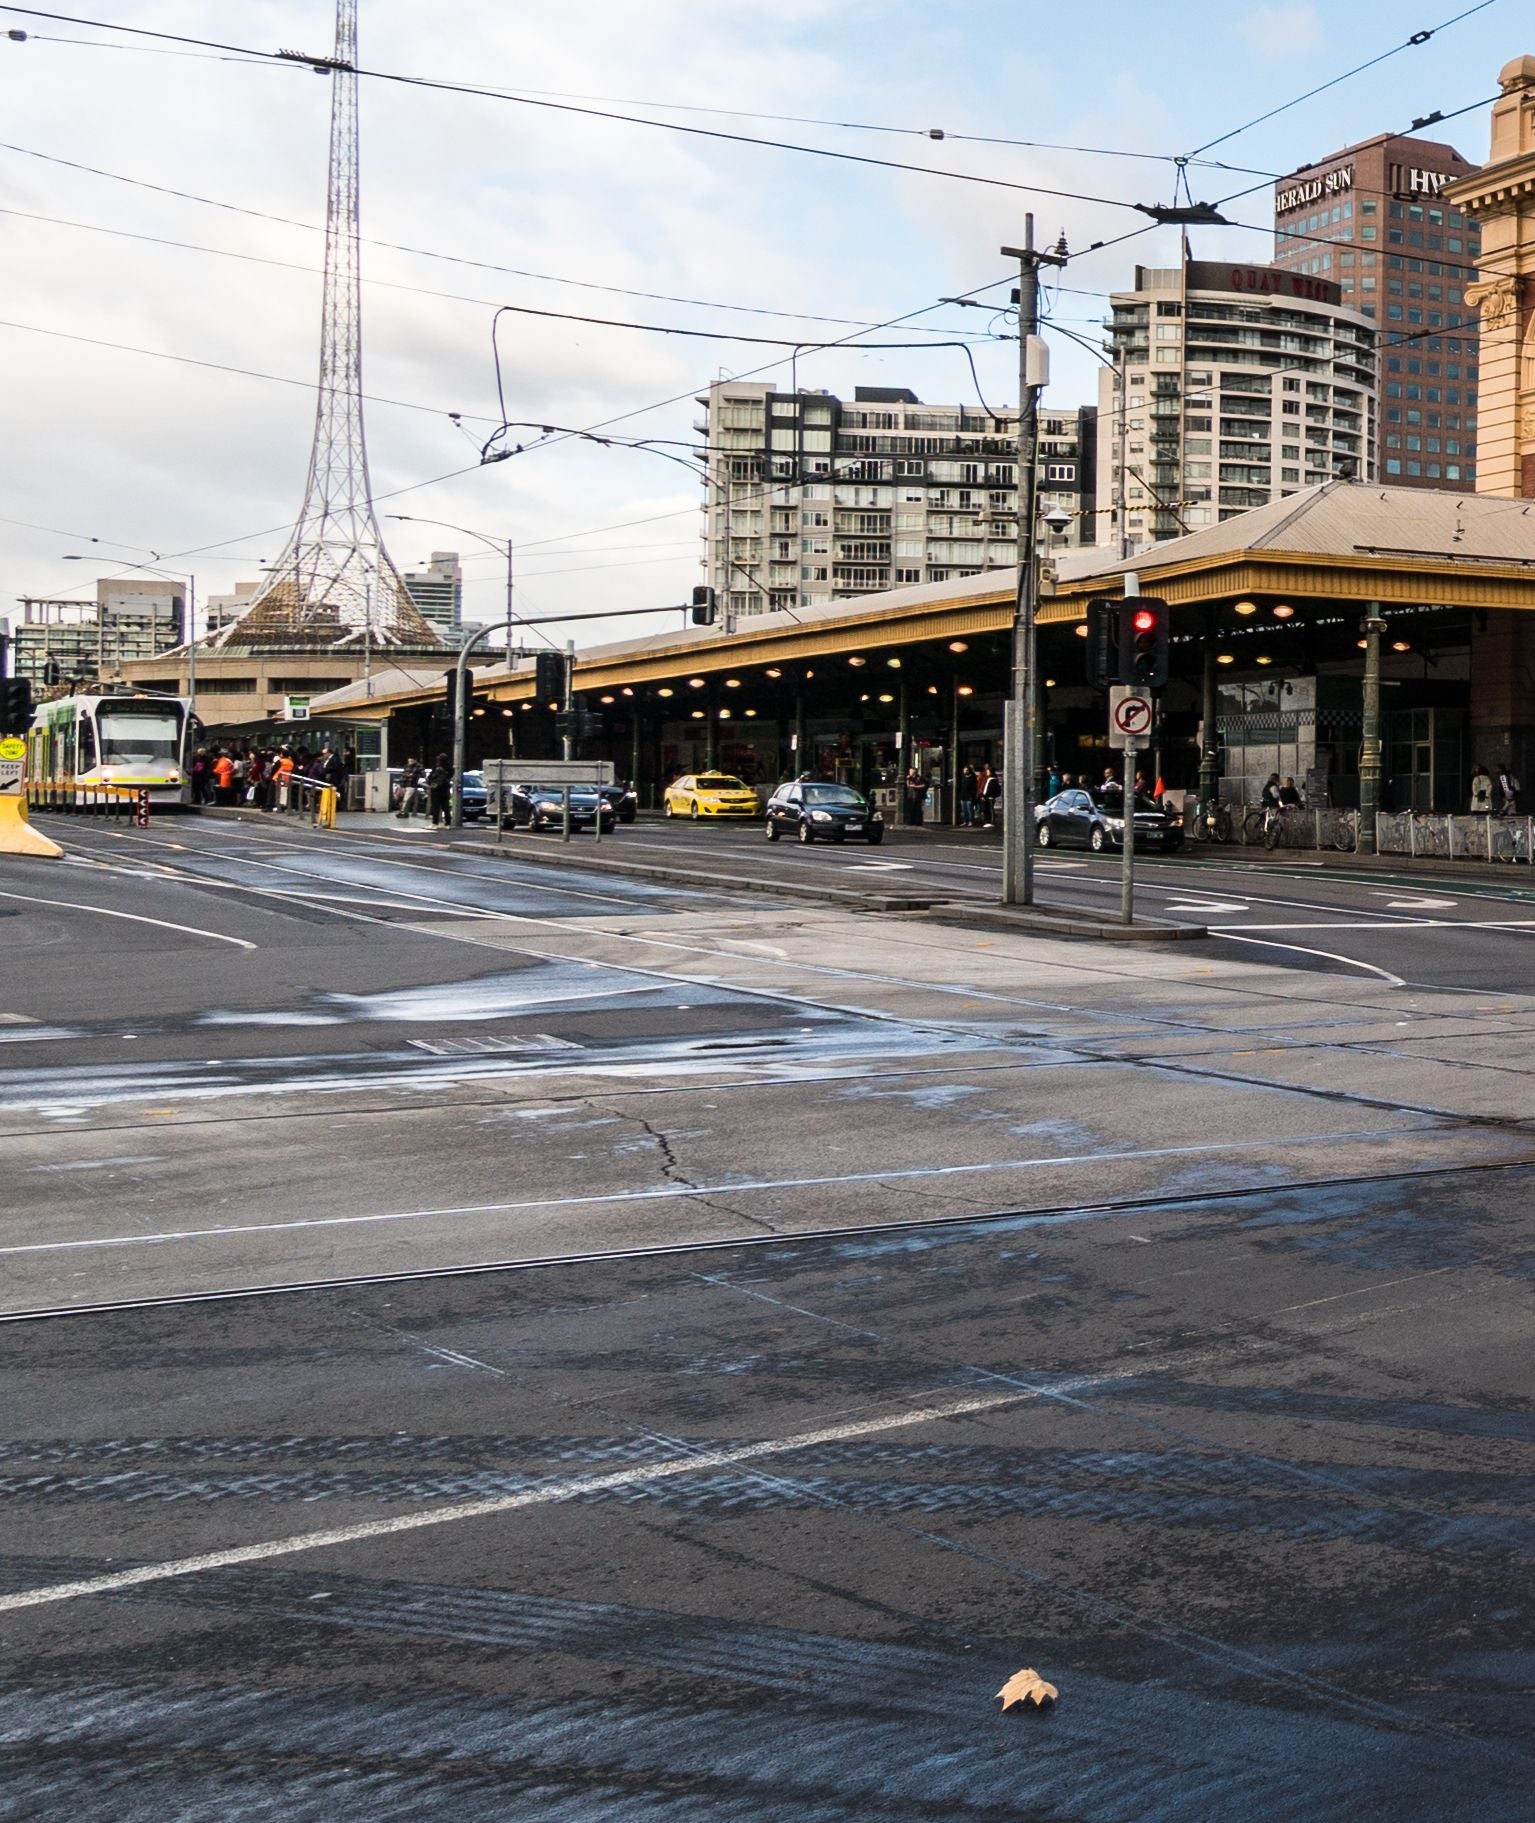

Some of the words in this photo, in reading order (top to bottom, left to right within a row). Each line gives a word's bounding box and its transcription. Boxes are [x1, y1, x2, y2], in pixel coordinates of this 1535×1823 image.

[1275, 179, 1322, 212] HERALD
[1326, 165, 1353, 193] SUN
[1410, 169, 1458, 194] HW
[1232, 269, 1282, 292] QUAY
